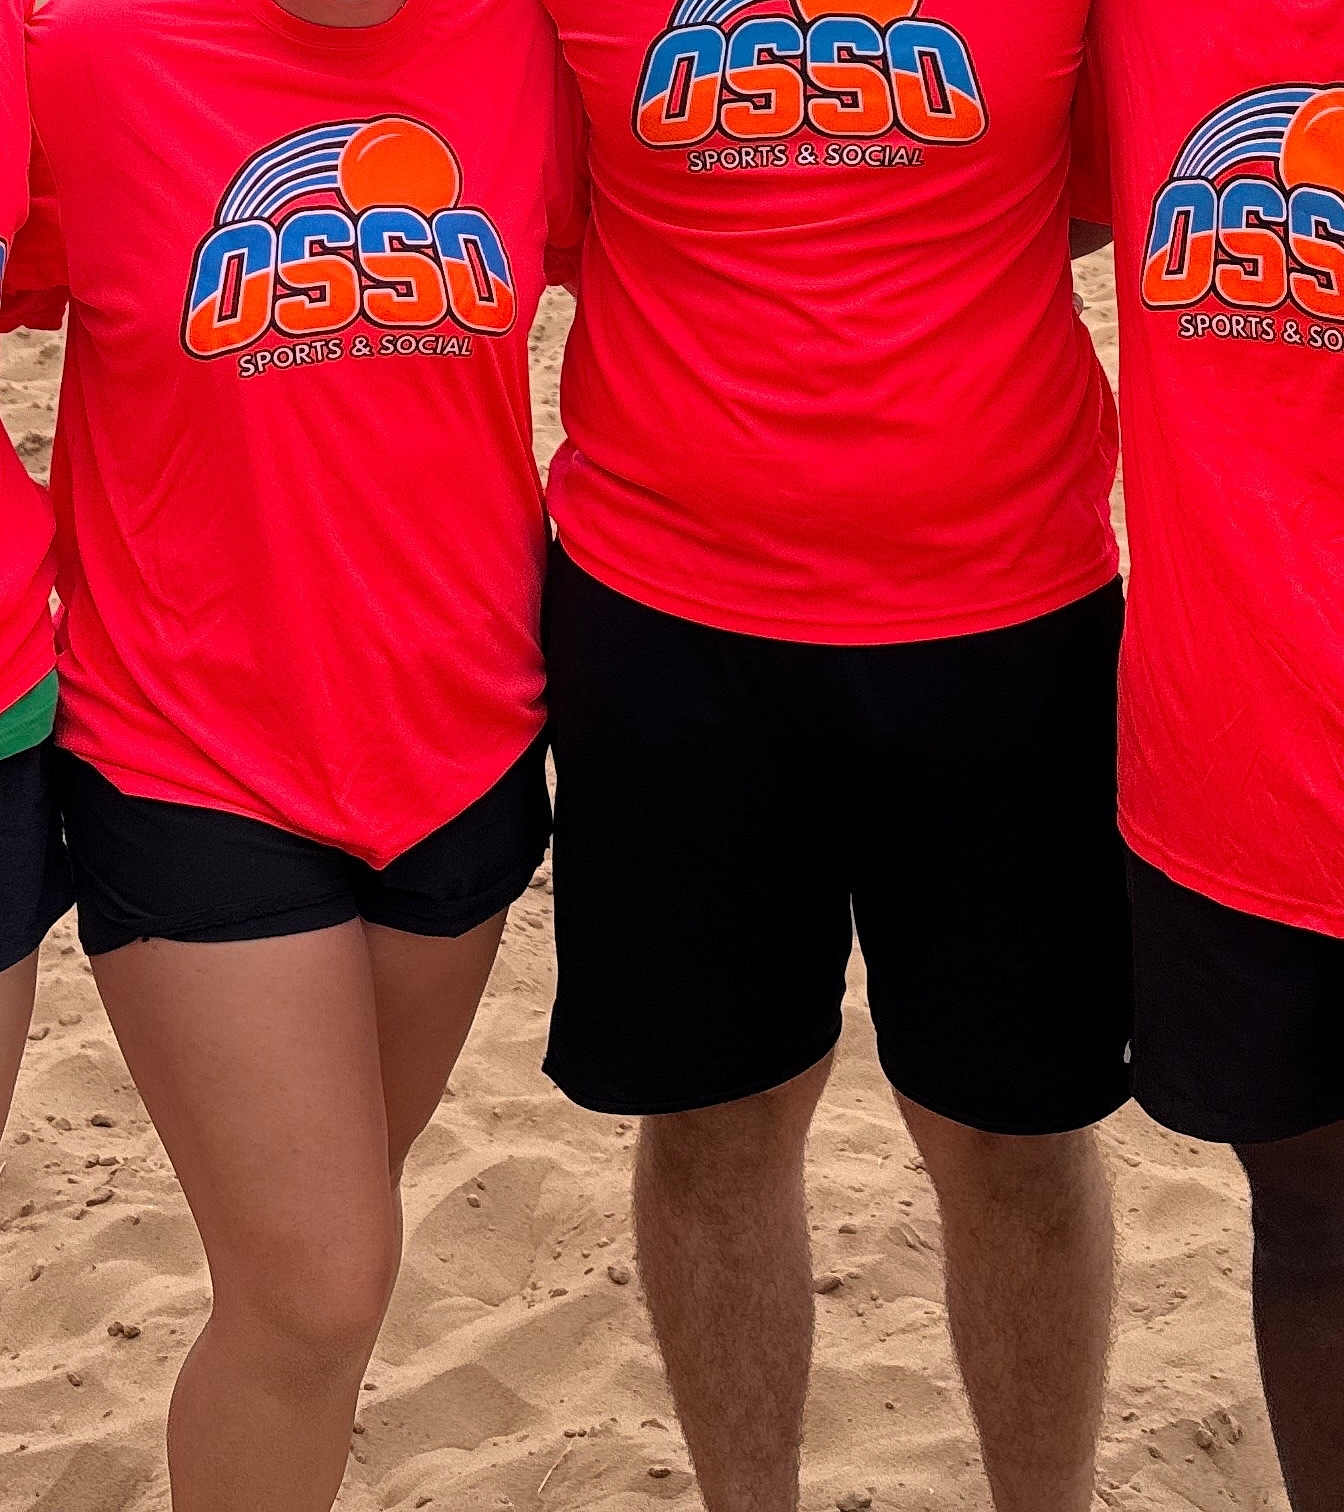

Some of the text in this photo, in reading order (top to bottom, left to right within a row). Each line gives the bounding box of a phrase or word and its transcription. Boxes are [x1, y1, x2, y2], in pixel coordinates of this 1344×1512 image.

[632, 14, 990, 150] OSSO
[687, 144, 925, 173] SPORTS & SOCIAL
[181, 206, 518, 360] OSSO
[1179, 314, 1274, 340] SPORTS
[1283, 320, 1301, 343] &
[239, 334, 474, 377] SPORTS & SOCIAL
